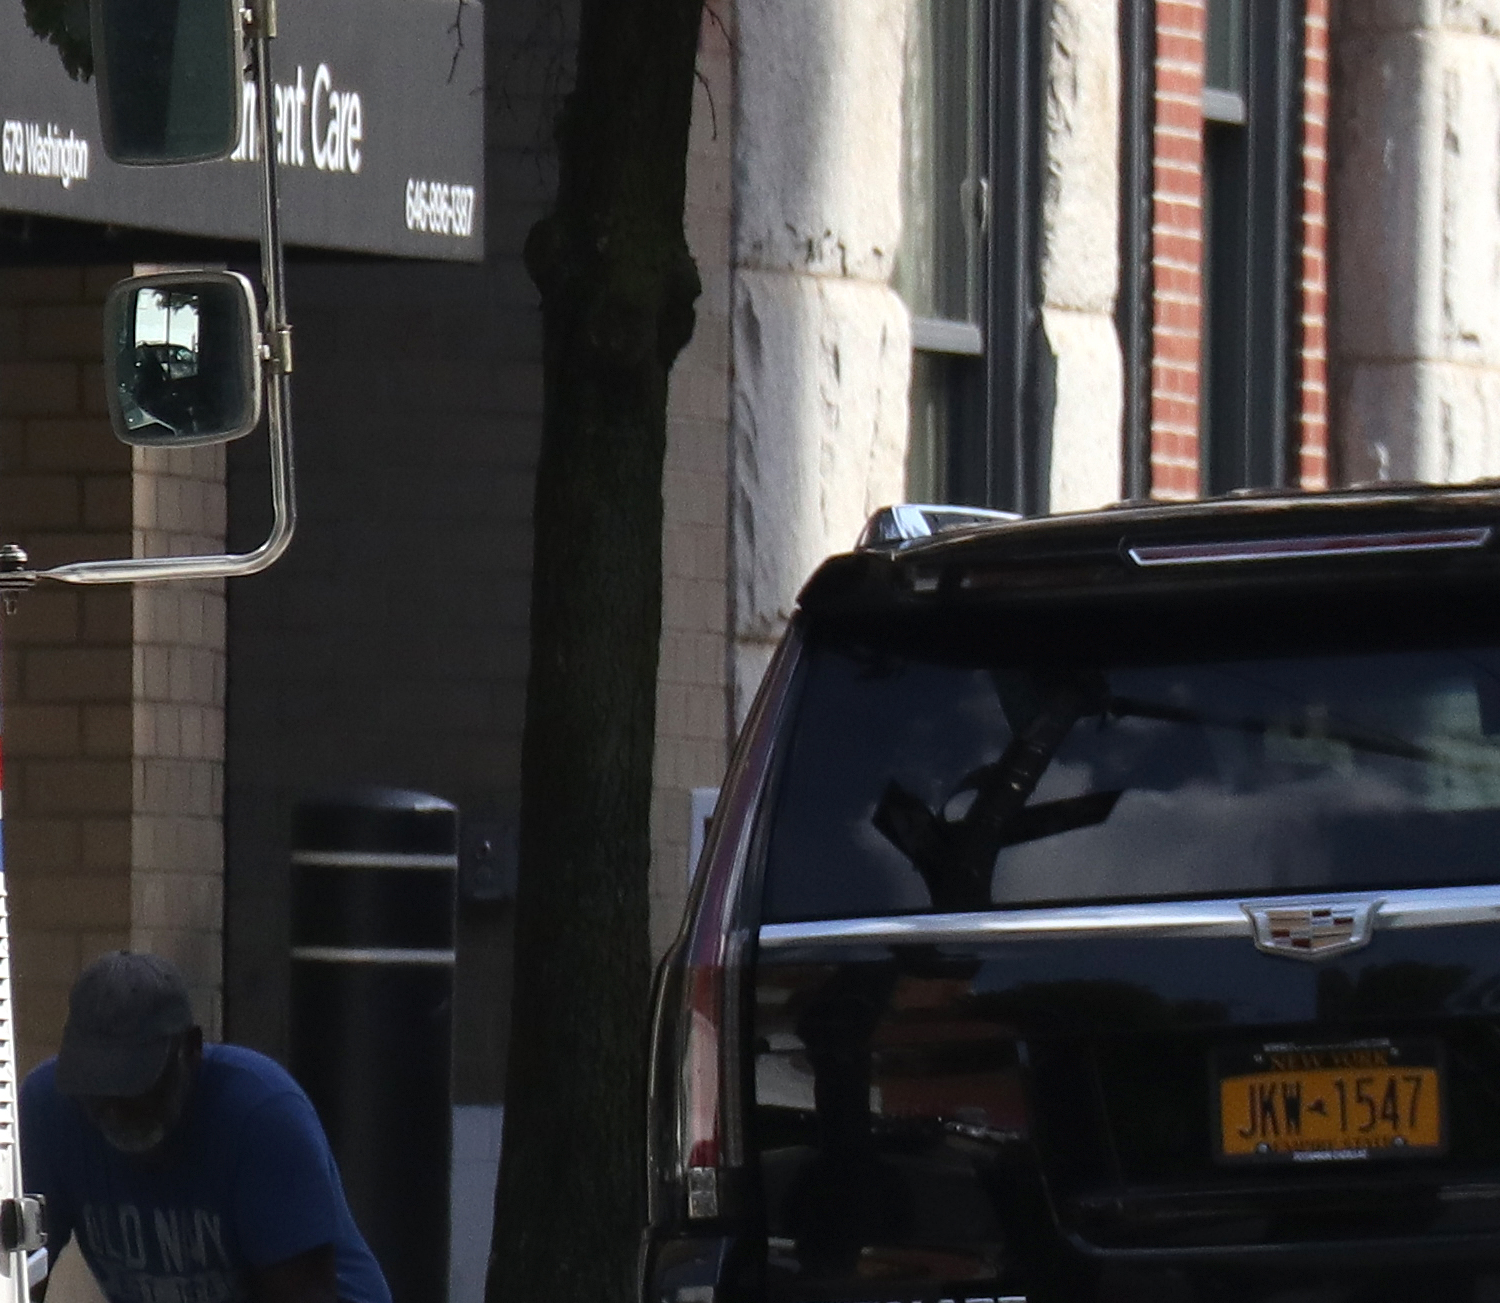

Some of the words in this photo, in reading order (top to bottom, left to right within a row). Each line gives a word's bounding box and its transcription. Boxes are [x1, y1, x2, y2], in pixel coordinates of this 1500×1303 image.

[310, 62, 363, 175] Care
[2, 119, 25, 175] 679
[25, 121, 88, 189] Washington
[1334, 1074, 1422, 1134] 1547
